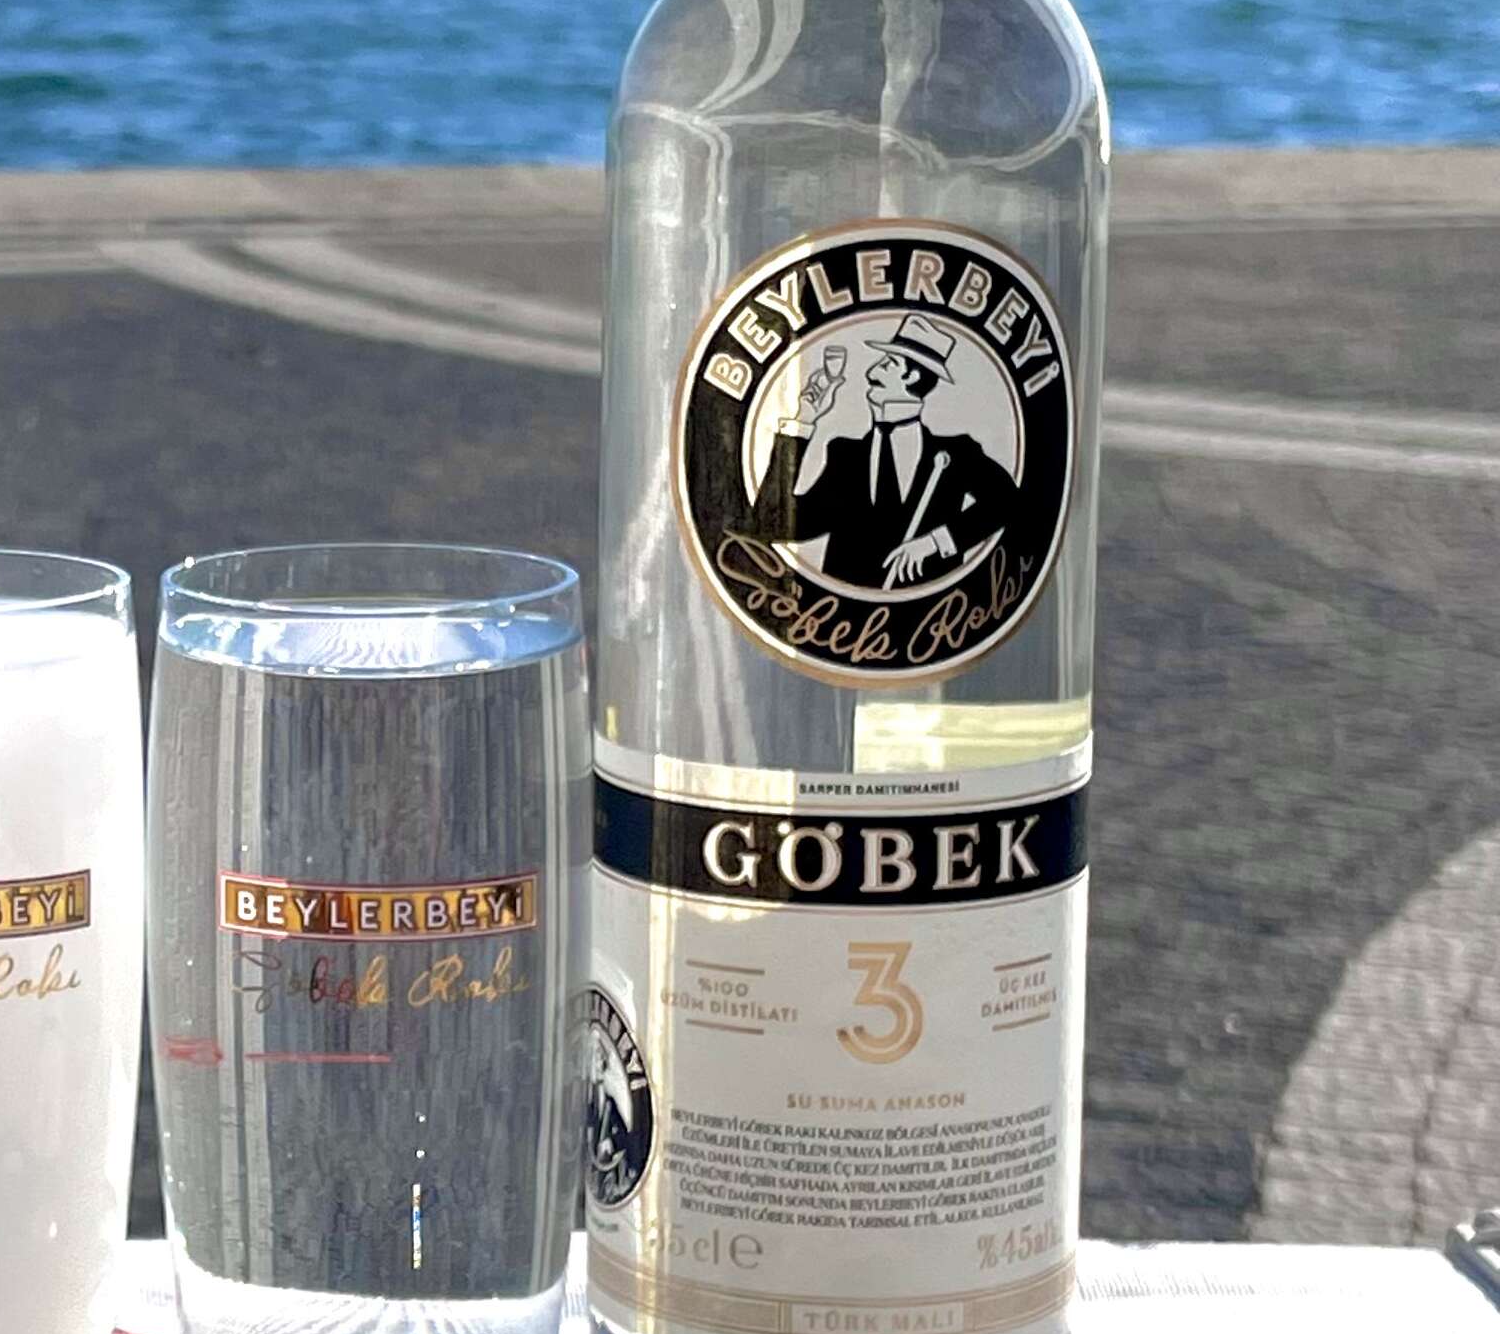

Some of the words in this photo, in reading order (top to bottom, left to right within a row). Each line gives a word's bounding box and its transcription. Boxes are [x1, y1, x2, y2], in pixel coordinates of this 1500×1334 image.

[704, 249, 1061, 402] BEYLERBEYİ
[799, 783, 851, 796] SARPER
[855, 779, 960, 796] DAMITIMHANESİ
[703, 813, 1042, 893] GÖBEK
[236, 887, 524, 933] BEYLERBEYİ
[698, 976, 749, 998] %100
[836, 941, 925, 1065] 3
[787, 1092, 812, 1109] SU
[819, 1094, 877, 1112] SUMA
[883, 1091, 965, 1112] ANASON
[804, 1310, 879, 1331] TÜRK
[891, 1309, 955, 1331] MALI
